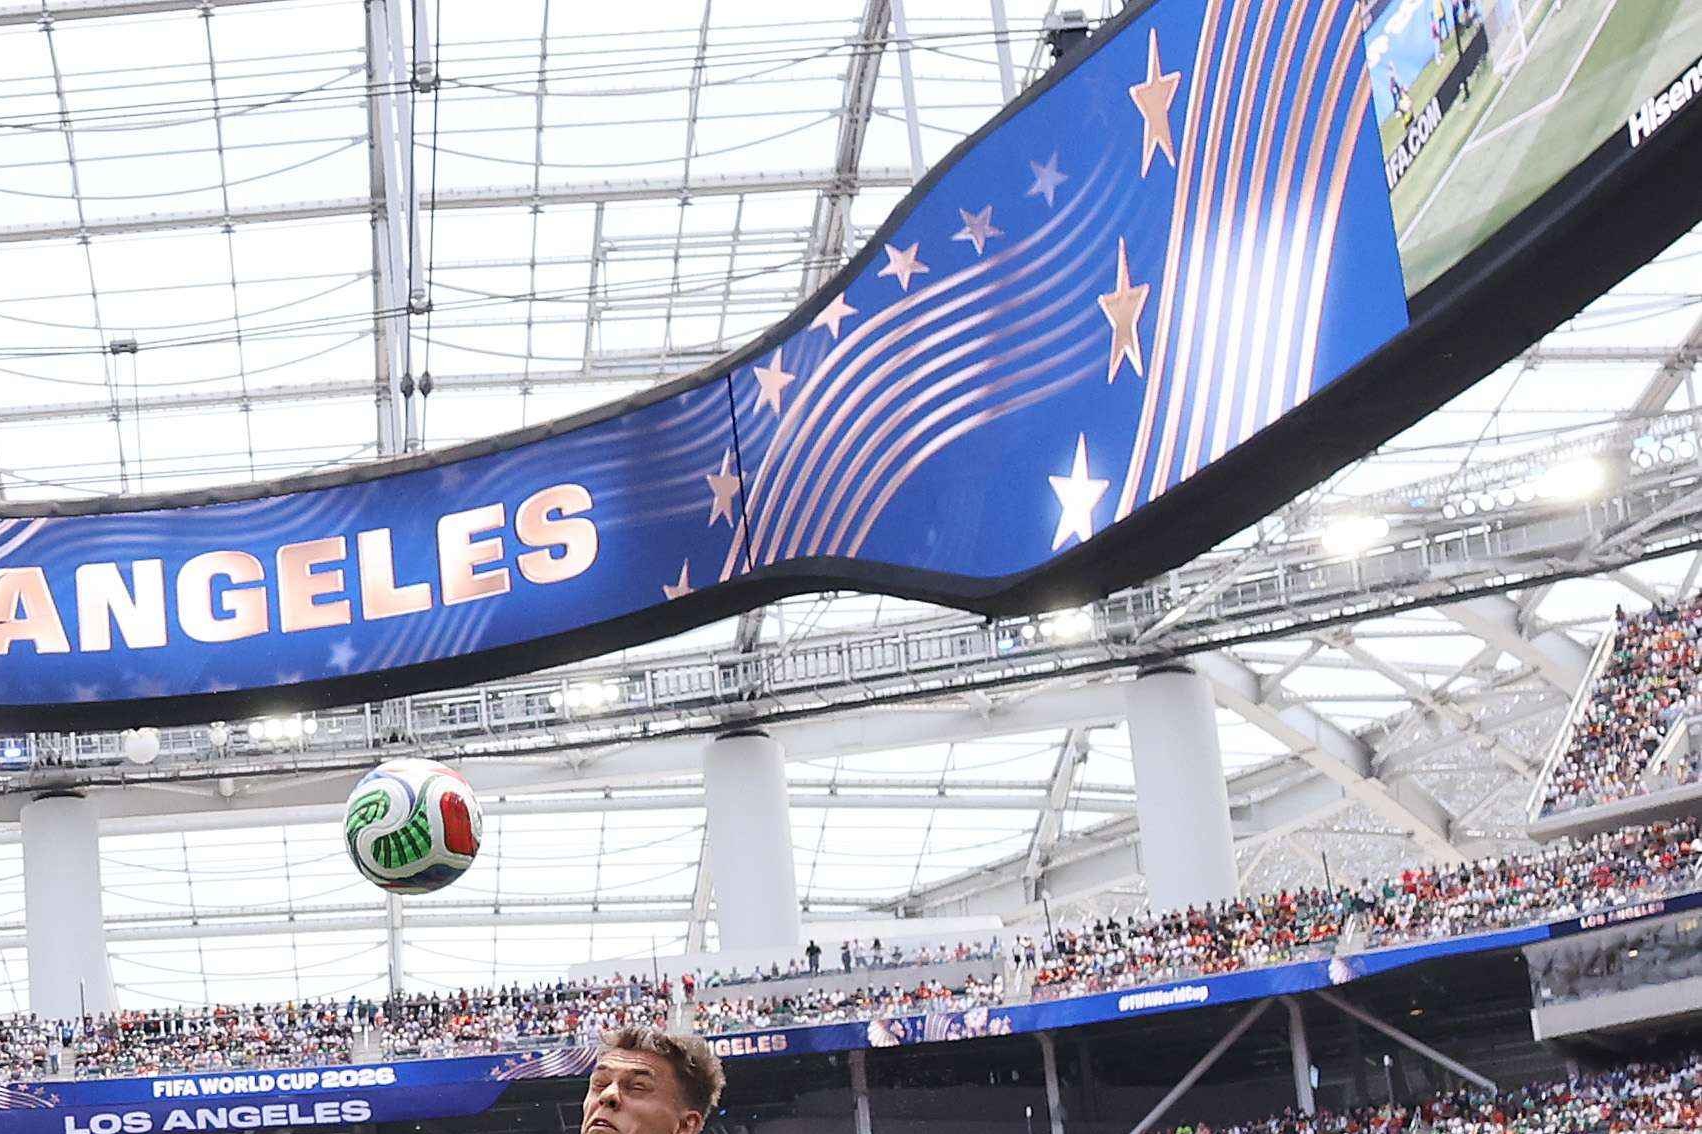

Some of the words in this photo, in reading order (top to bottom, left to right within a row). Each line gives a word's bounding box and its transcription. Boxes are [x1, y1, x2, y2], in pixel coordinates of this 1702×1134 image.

[152, 1078, 198, 1098] FIFA
[200, 1074, 277, 1095] WORLD
[277, 1072, 319, 1091] CUP
[320, 1067, 396, 1089] 2026
[163, 1100, 371, 1131] ANGELES
